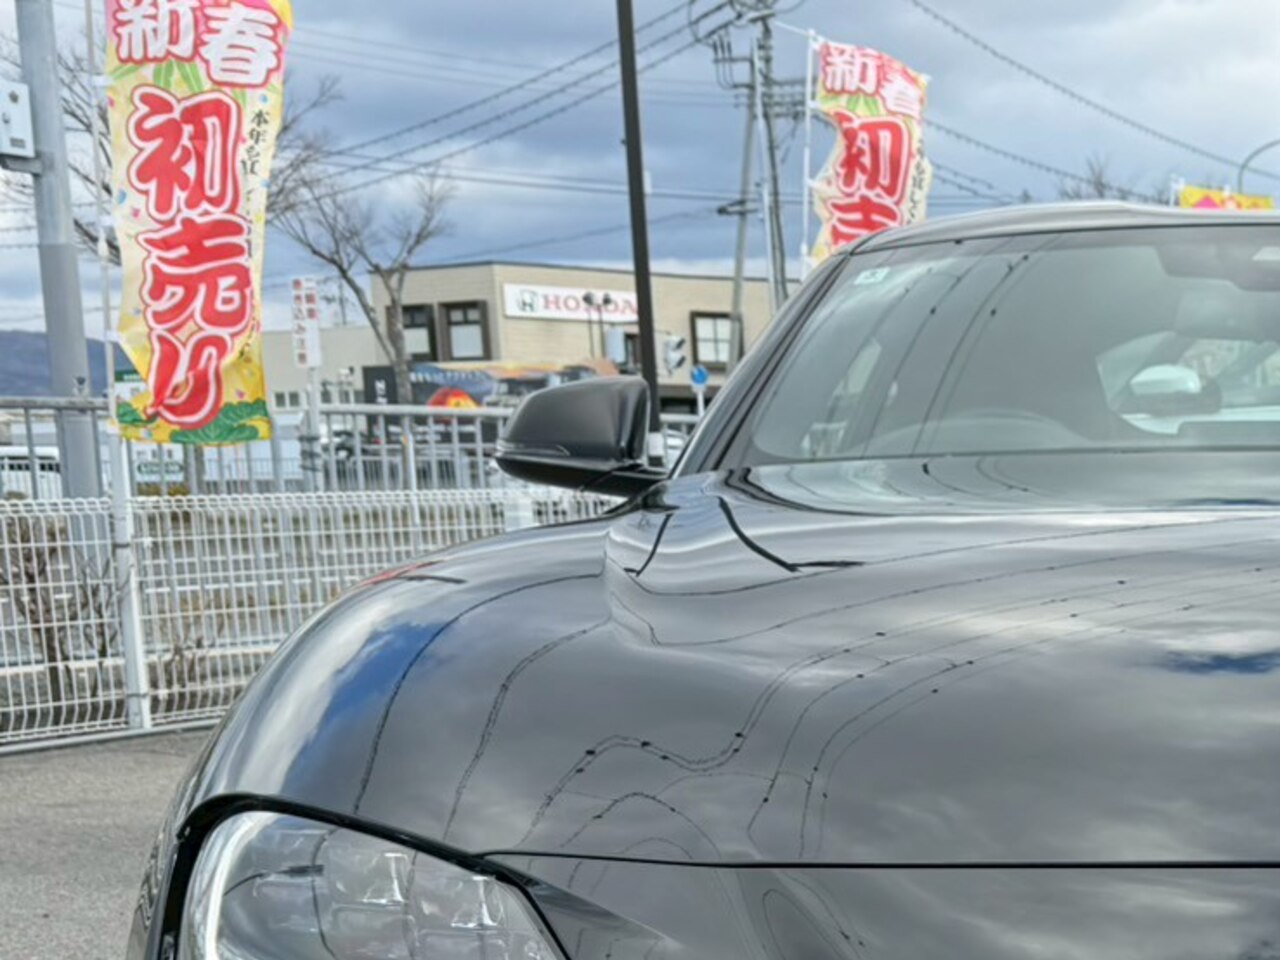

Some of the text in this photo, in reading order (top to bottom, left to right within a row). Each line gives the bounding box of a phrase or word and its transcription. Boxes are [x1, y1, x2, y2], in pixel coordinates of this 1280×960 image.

[114, 0, 281, 86] 新春
[130, 87, 250, 426] 初売り
